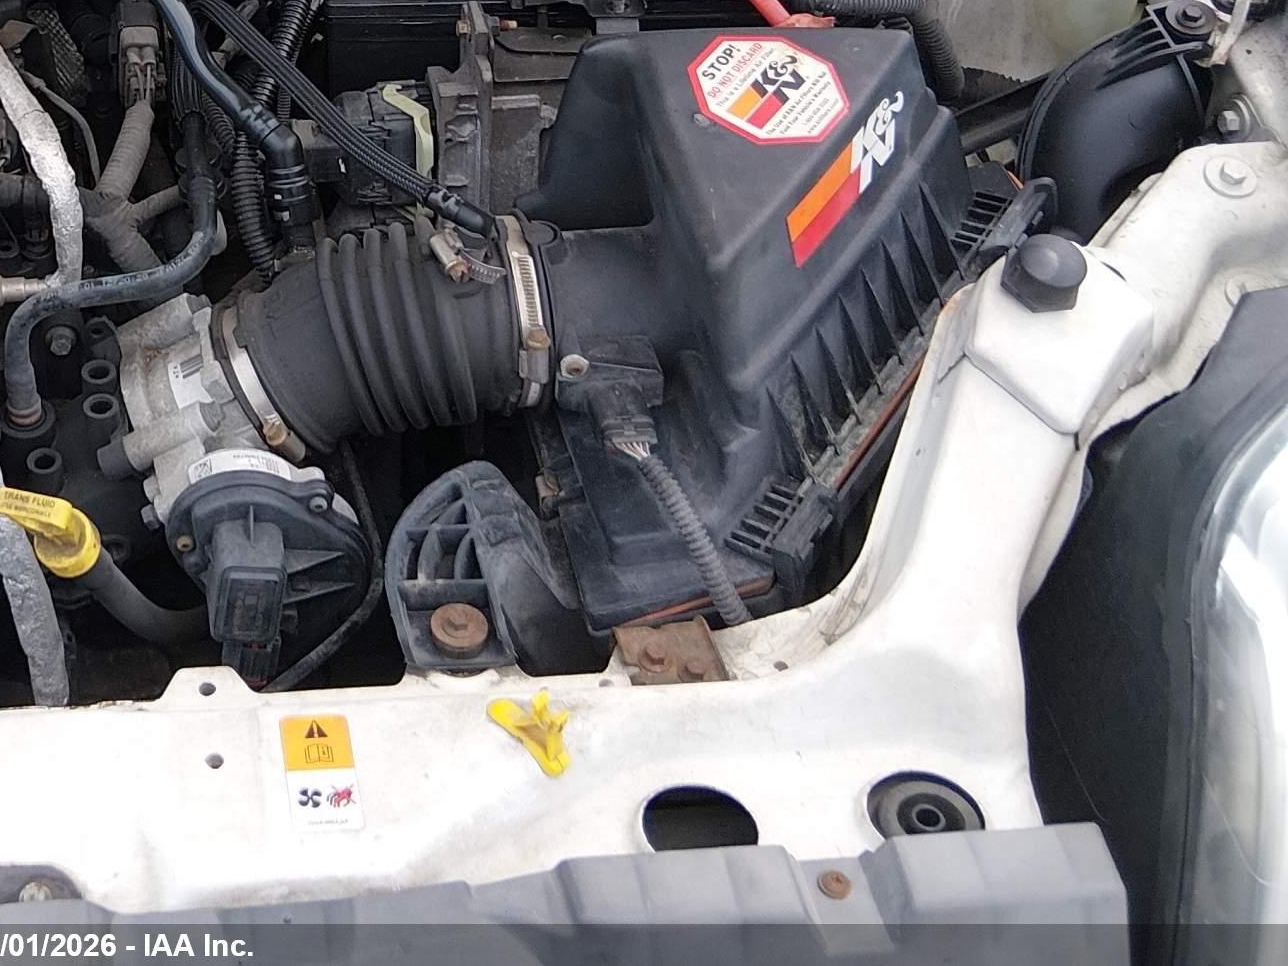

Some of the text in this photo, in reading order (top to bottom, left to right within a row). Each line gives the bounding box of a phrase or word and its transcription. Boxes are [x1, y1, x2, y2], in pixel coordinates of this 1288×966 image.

[702, 44, 741, 80] STOP!
[707, 42, 762, 99] DO NOT DISCARD
[750, 52, 806, 105] K&N
[849, 91, 904, 194] K&N
[4, 491, 56, 508] TRANS FLUID
